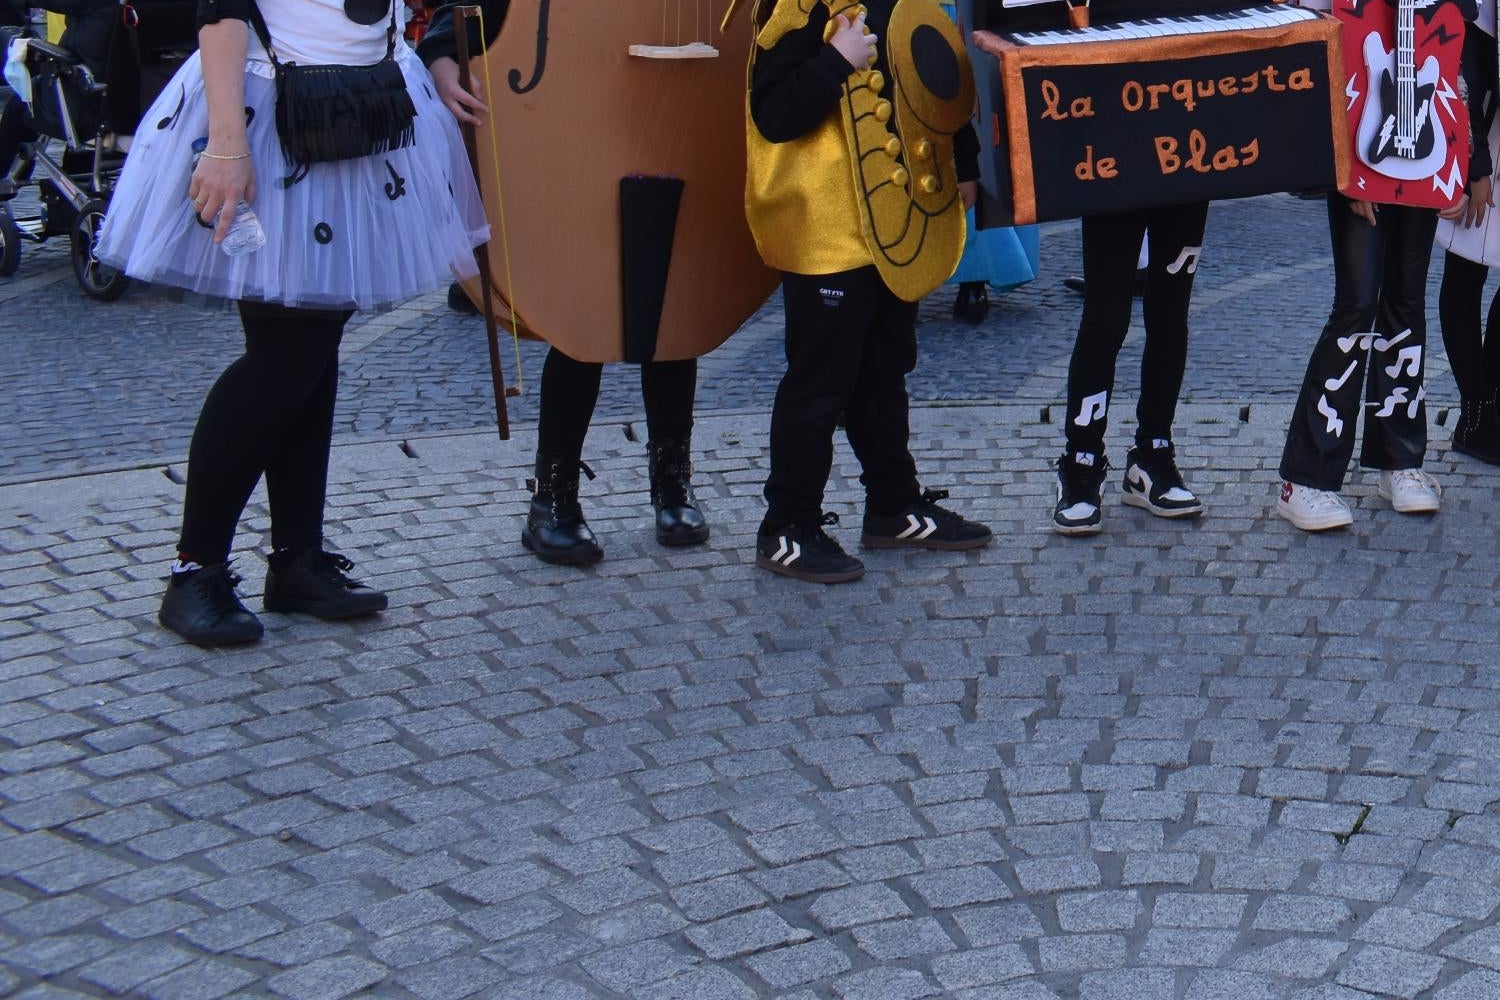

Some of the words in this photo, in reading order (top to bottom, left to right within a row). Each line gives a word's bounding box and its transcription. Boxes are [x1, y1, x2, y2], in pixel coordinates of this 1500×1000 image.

[1121, 65, 1315, 112] Orquesta
[1074, 145, 1119, 181] de
[1154, 128, 1260, 175] Blas
